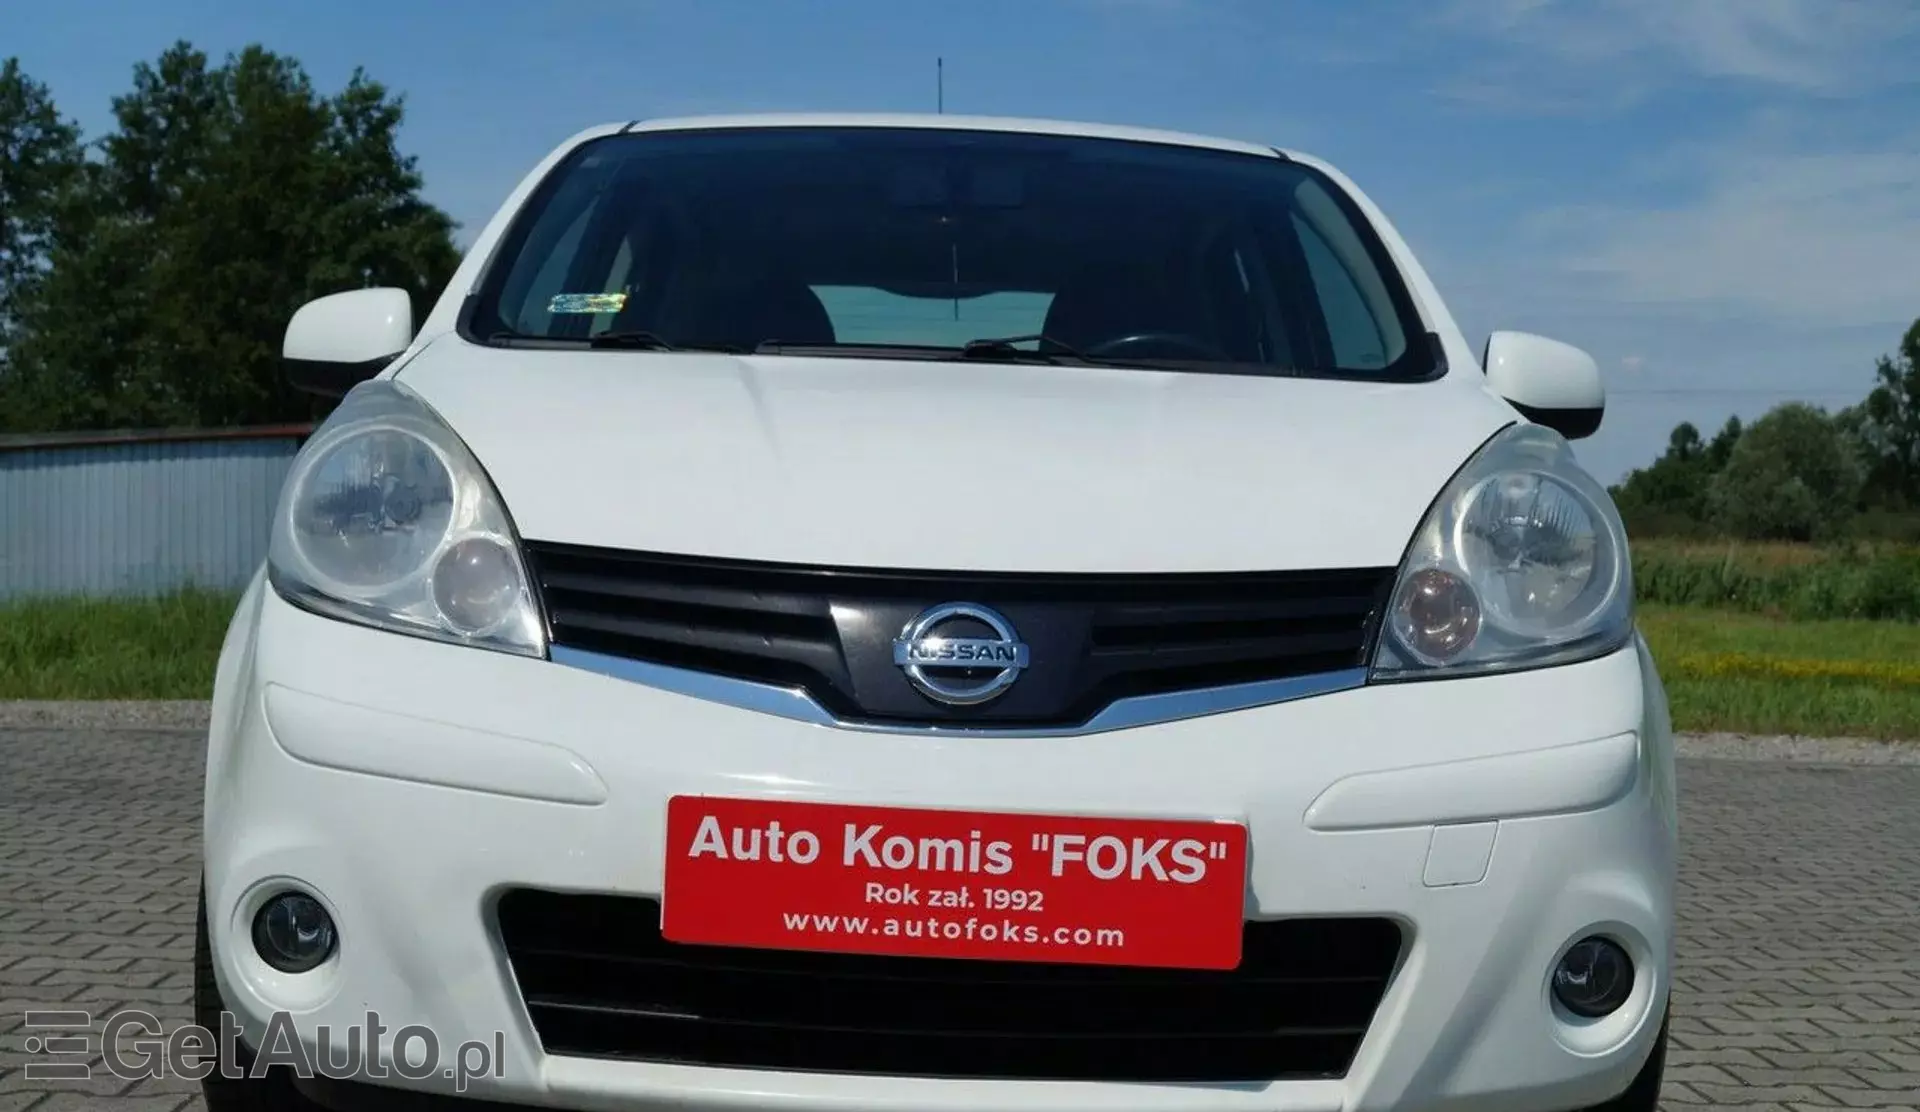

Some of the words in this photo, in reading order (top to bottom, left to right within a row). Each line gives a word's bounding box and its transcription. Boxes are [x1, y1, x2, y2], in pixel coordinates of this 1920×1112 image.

[909, 643, 1016, 662] NISSAN
[688, 815, 820, 864] Auto
[843, 823, 1013, 875] Komis
[1031, 833, 1227, 884] "FOKS"
[865, 882, 920, 906] Rok
[927, 886, 975, 909] zał.
[982, 888, 1044, 912] 1992
[783, 913, 1124, 947] www.autofoks.com
